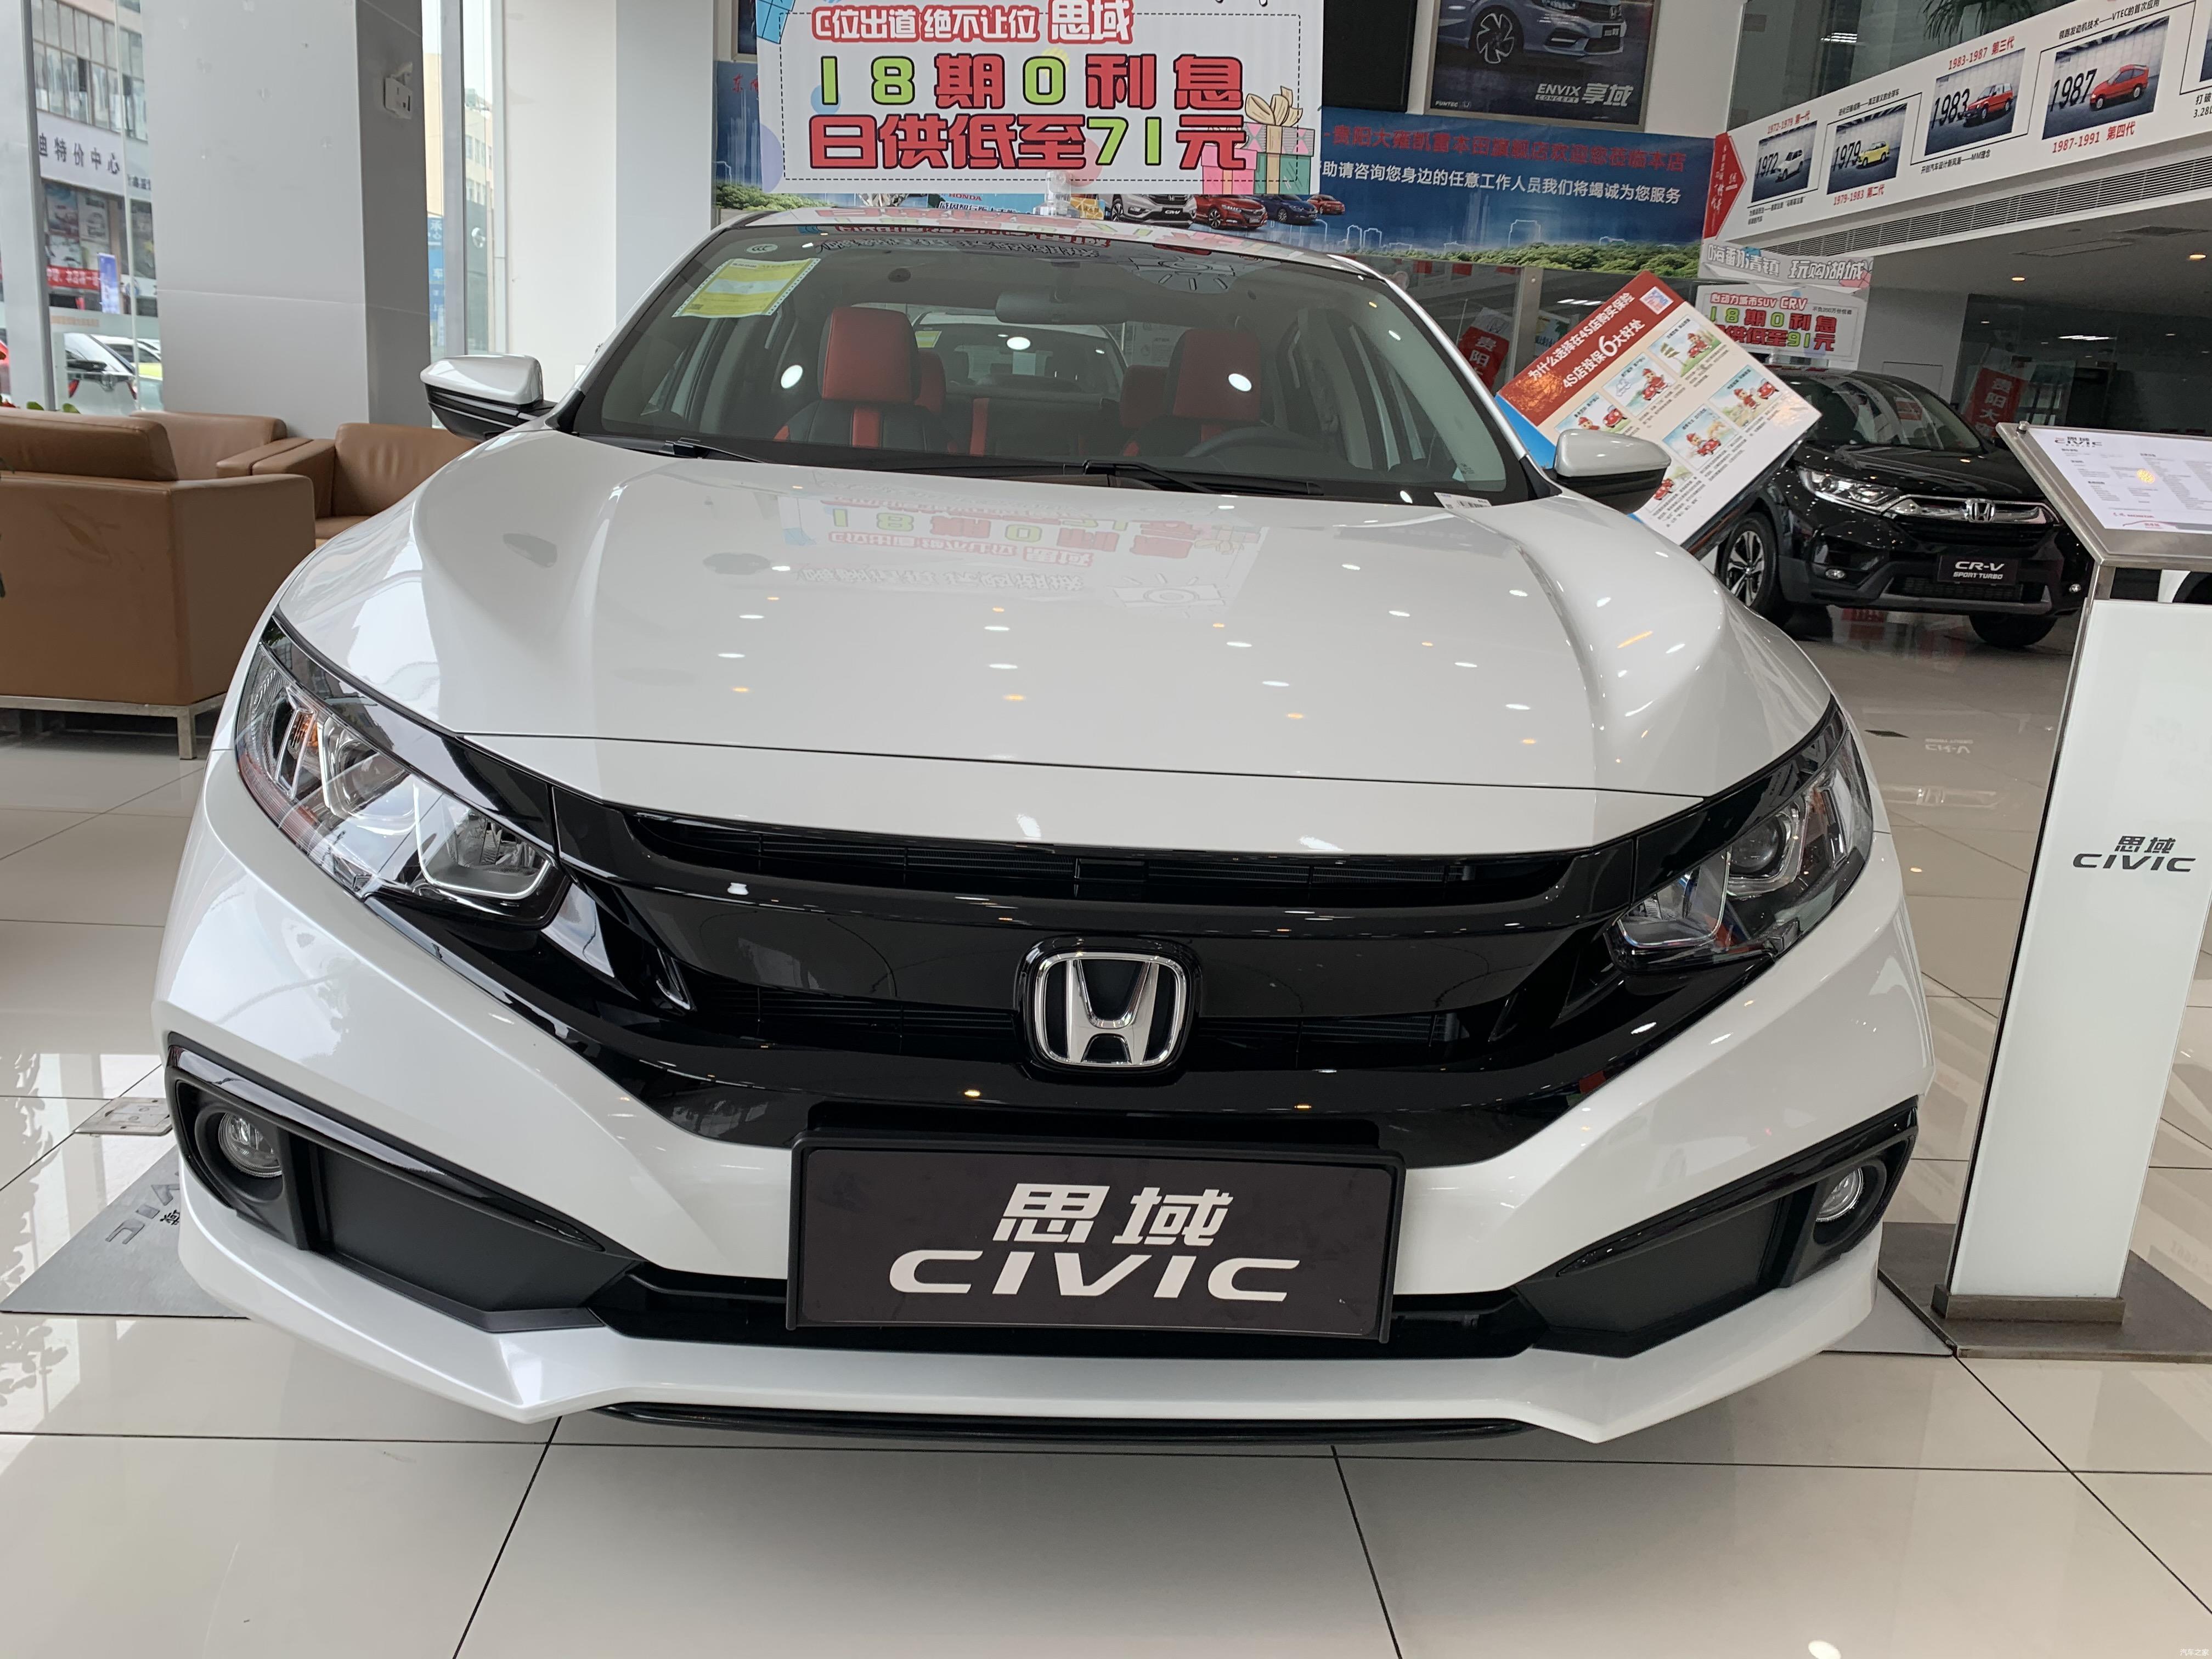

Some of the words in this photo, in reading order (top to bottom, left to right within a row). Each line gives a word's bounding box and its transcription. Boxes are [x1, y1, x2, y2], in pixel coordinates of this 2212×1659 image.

[814, 7, 918, 41] C位出道
[923, 7, 1038, 41] 绝不让位
[1051, 0, 1132, 41] 思域
[1949, 47, 1988, 70] 1983-1987
[1991, 36, 2015, 55] 第三代
[821, 54, 1244, 110] 18期0利息
[1537, 83, 1582, 96] ENVIX
[1582, 83, 1634, 107] 享域
[2050, 69, 2097, 112] 1987
[1795, 110, 1810, 125] 第一代
[1930, 88, 1970, 130] 1983
[809, 114, 1249, 170] 日供低至71元
[2052, 132, 2100, 153] 1987-1991
[2107, 121, 2136, 140] 第四代
[1832, 140, 1861, 172] 1979
[1318, 160, 1681, 204] 助请咨询您身边的任意工作人员我们将竭诚为您服务
[1866, 184, 1885, 198] 第二代
[1787, 259, 1866, 280] 玩购湖城
[1780, 296, 1808, 311] CRV
[1709, 306, 1837, 334] 18期0利息
[1527, 291, 1634, 382] 为什么选择在4S店购买保险
[1563, 318, 1646, 390] 4S店投保6大好处
[1955, 561, 2005, 571] CR-V
[2114, 836, 2176, 854] 思域
[2073, 853, 2196, 872] CIVIC
[992, 1182, 1234, 1246] 思域
[889, 1249, 1301, 1302] CIVIC
